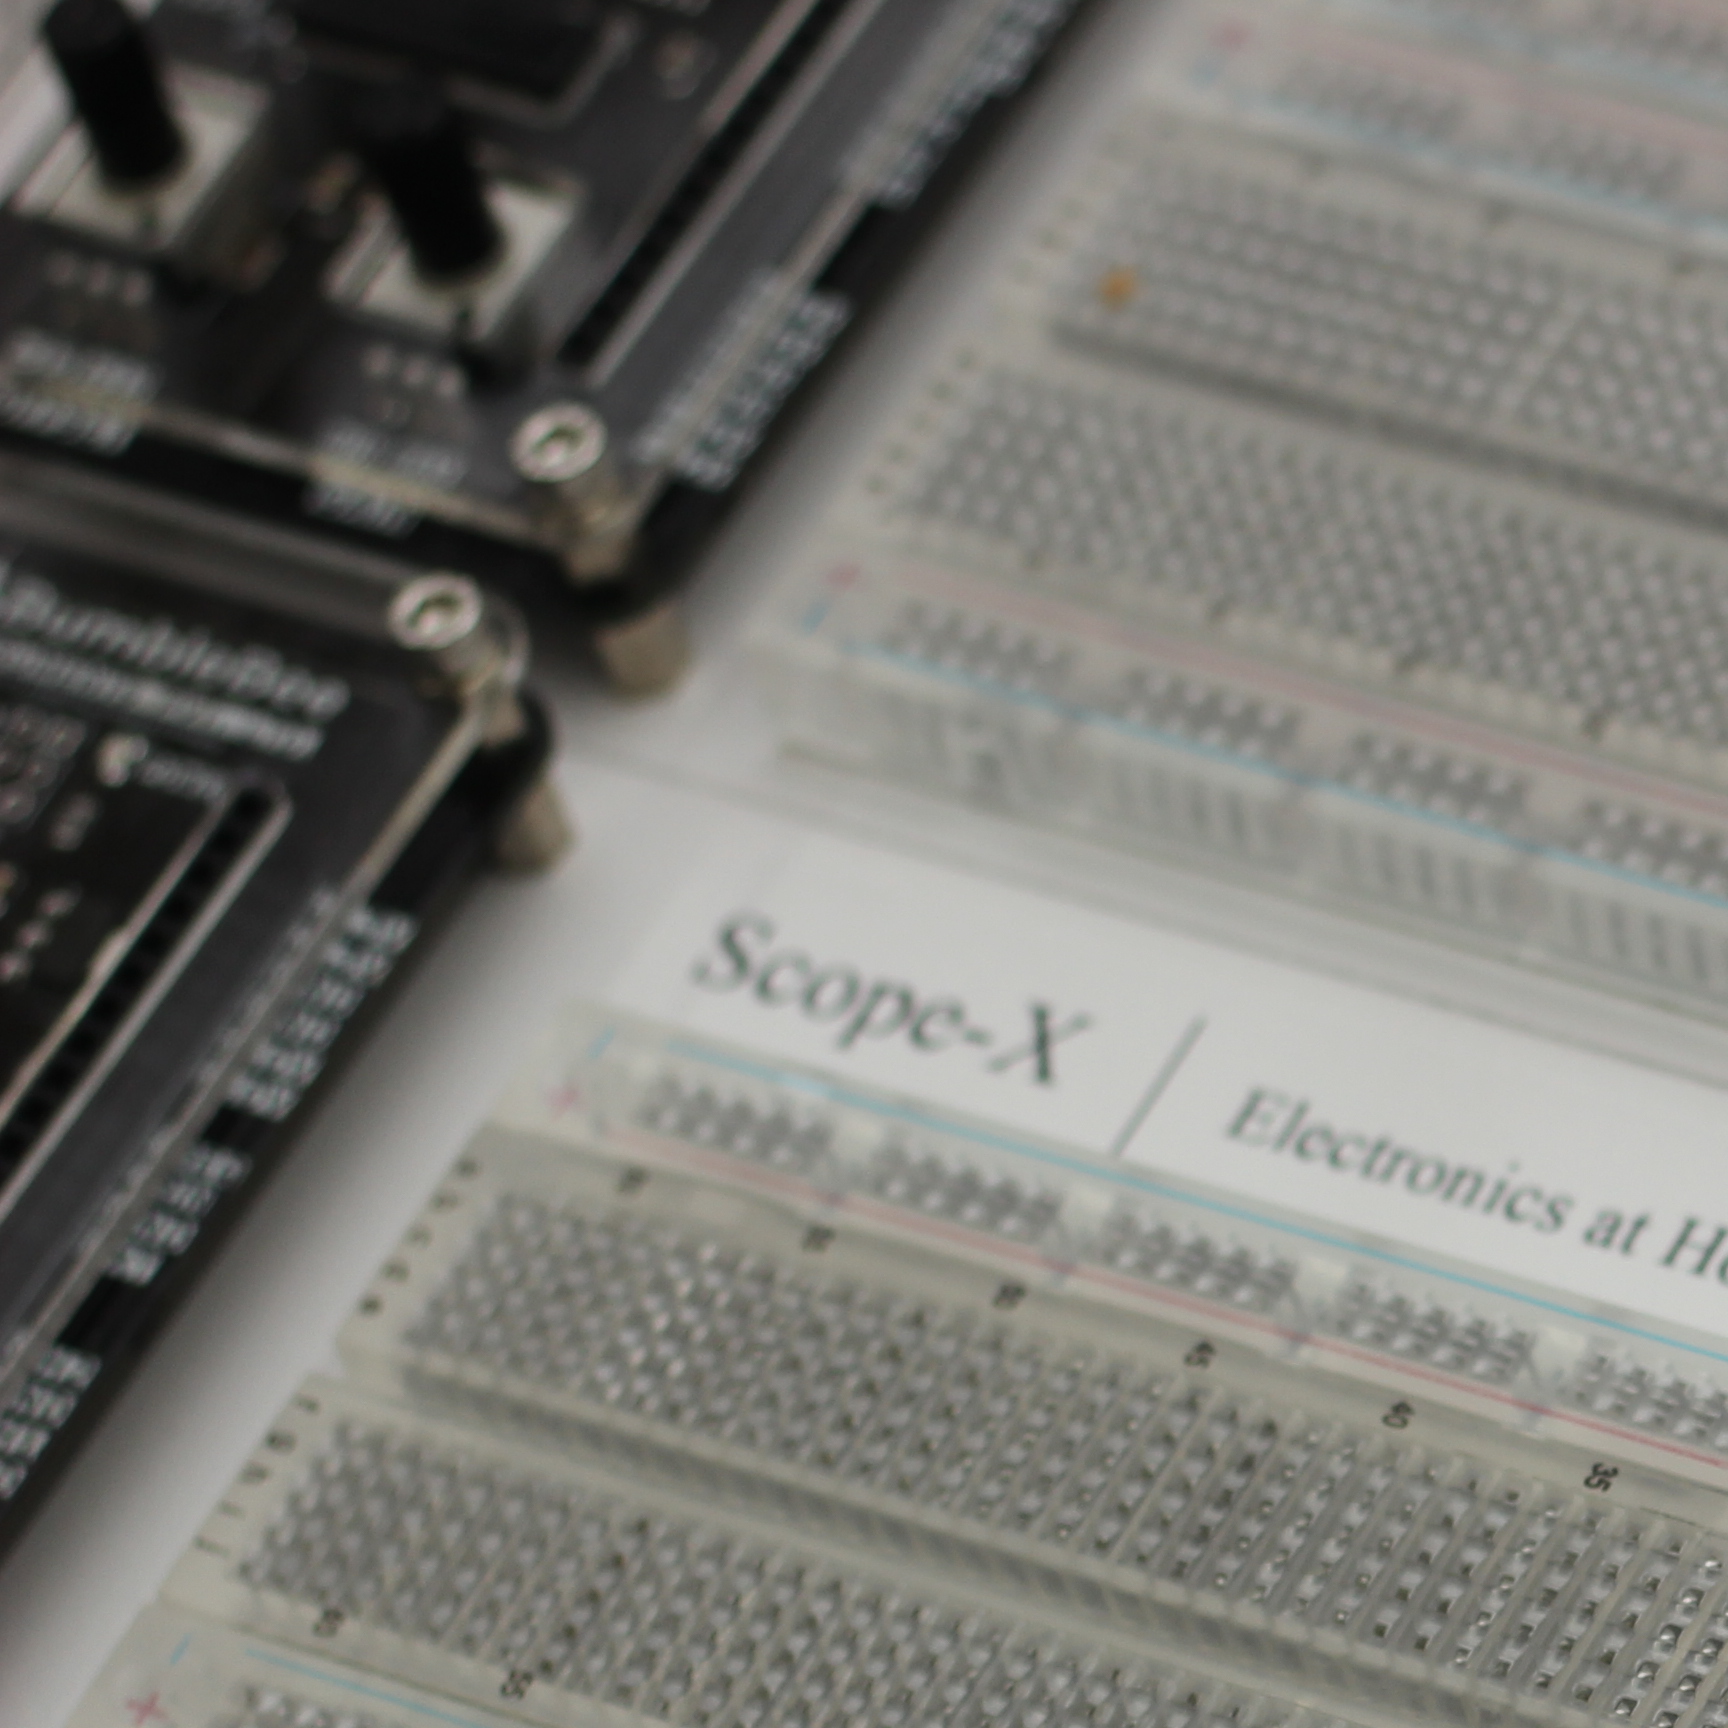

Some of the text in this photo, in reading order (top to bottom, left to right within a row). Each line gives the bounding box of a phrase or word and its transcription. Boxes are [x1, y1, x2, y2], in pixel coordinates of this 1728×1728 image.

[688, 906, 1096, 1092] Scope-X
[1222, 1082, 1572, 1240] Electronics
[1580, 1205, 1652, 1257] at
[1584, 1460, 1619, 1493] 35
